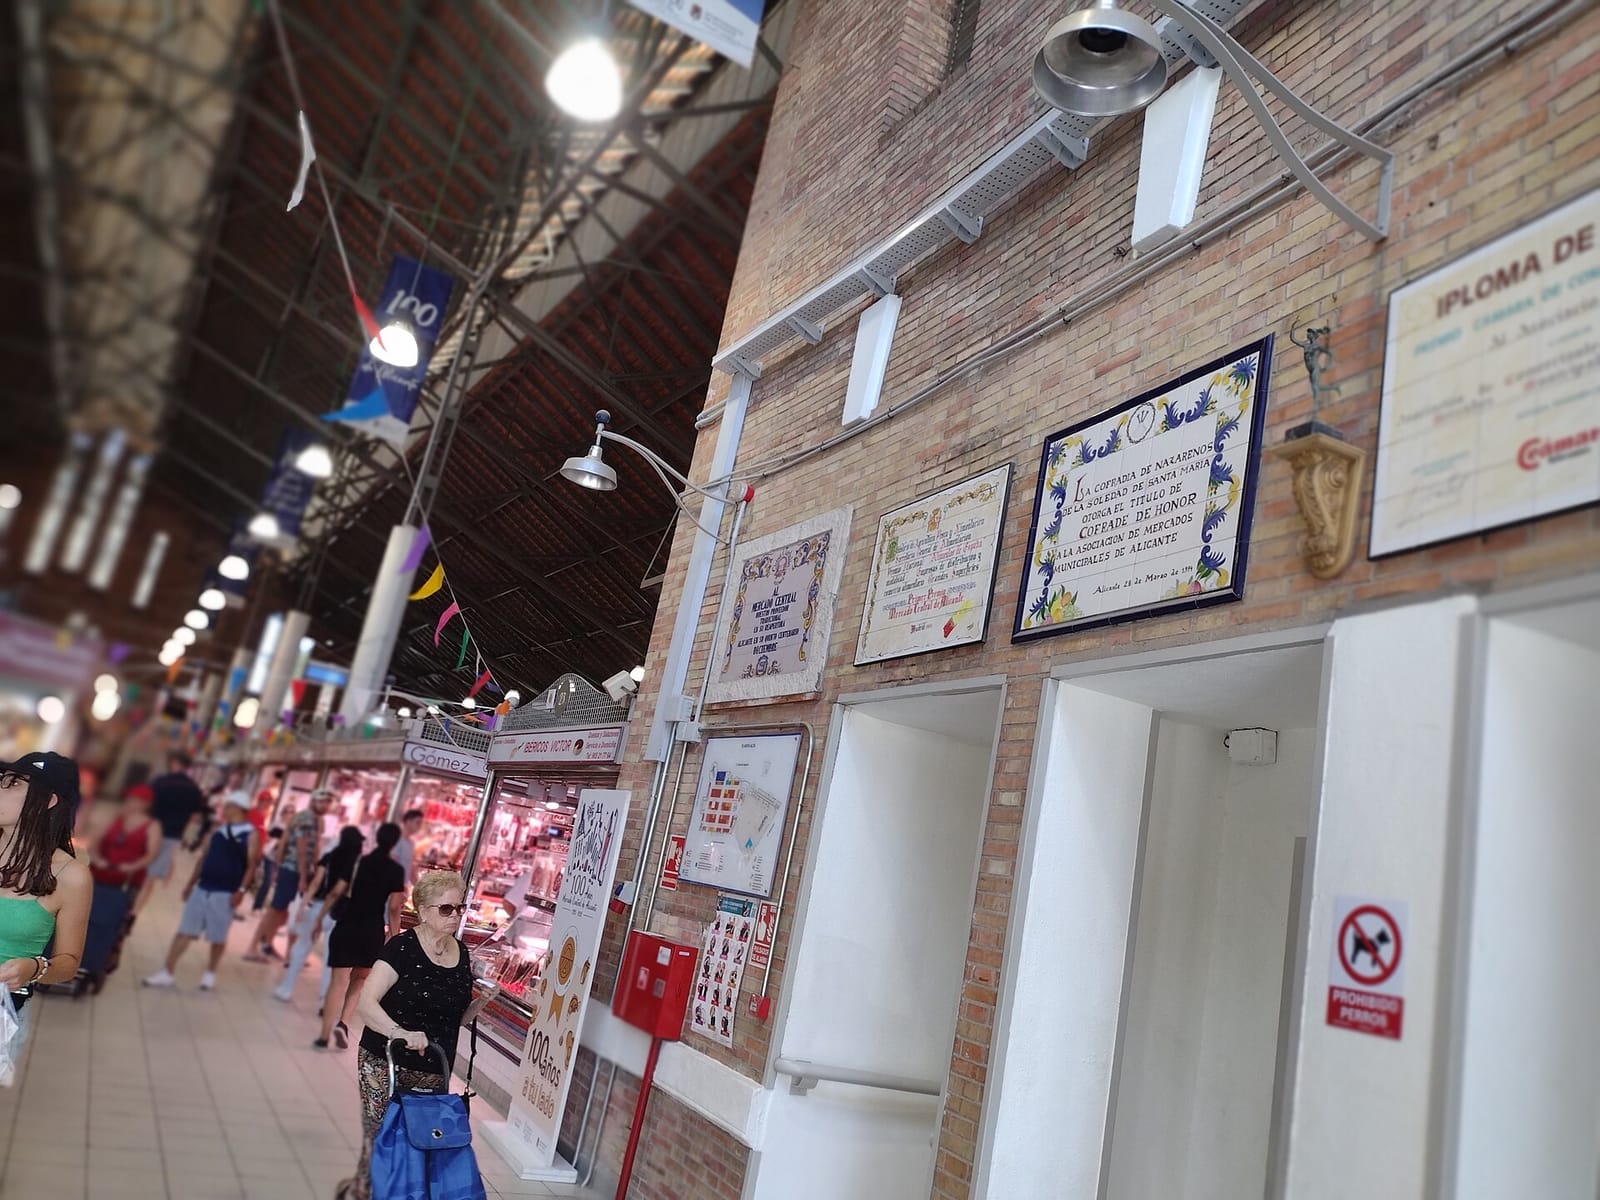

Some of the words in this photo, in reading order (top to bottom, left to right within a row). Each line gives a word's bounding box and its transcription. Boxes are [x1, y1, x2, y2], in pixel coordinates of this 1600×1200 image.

[1554, 224, 1595, 265] DE
[1062, 506, 1073, 518] DE
[1074, 503, 1085, 514] LA
[1086, 487, 1129, 510] SOLEDAD
[1131, 481, 1144, 494] DE
[1148, 470, 1177, 489] SANTA
[1179, 458, 1211, 477] MARIA
[1094, 470, 1138, 494] COFRADIA
[1140, 463, 1153, 477] DE
[1155, 442, 1214, 473] NAZARENOS
[1079, 514, 1129, 540] COFRADE
[1135, 509, 1151, 524] DE
[1154, 492, 1198, 519] HONOR
[1080, 507, 1113, 526] OTORGA
[1114, 502, 1125, 515] EL
[1130, 490, 1166, 511] TITULO
[1169, 480, 1184, 496] DE
[1053, 549, 1110, 574] MUNICIPALES
[1114, 548, 1125, 559] DE
[1129, 531, 1178, 555] ALICANTE
[1056, 552, 1062, 561] A
[1063, 549, 1073, 559] LA
[1074, 533, 1124, 556] ASOCIACION
[1128, 528, 1140, 541] DE
[1143, 512, 1194, 537] MERCADOS
[752, 598, 774, 612] MERCADO
[775, 592, 797, 607] CENTRAL
[1092, 582, 1121, 595] Alicante
[1134, 577, 1142, 586] de
[1170, 569, 1179, 578] de
[411, 746, 471, 774] Gómez
[550, 739, 572, 752] VICTOR
[571, 874, 587, 896] 100
[528, 1028, 549, 1070] 100
[540, 1055, 561, 1089] años
[536, 1084, 554, 1119] lado
